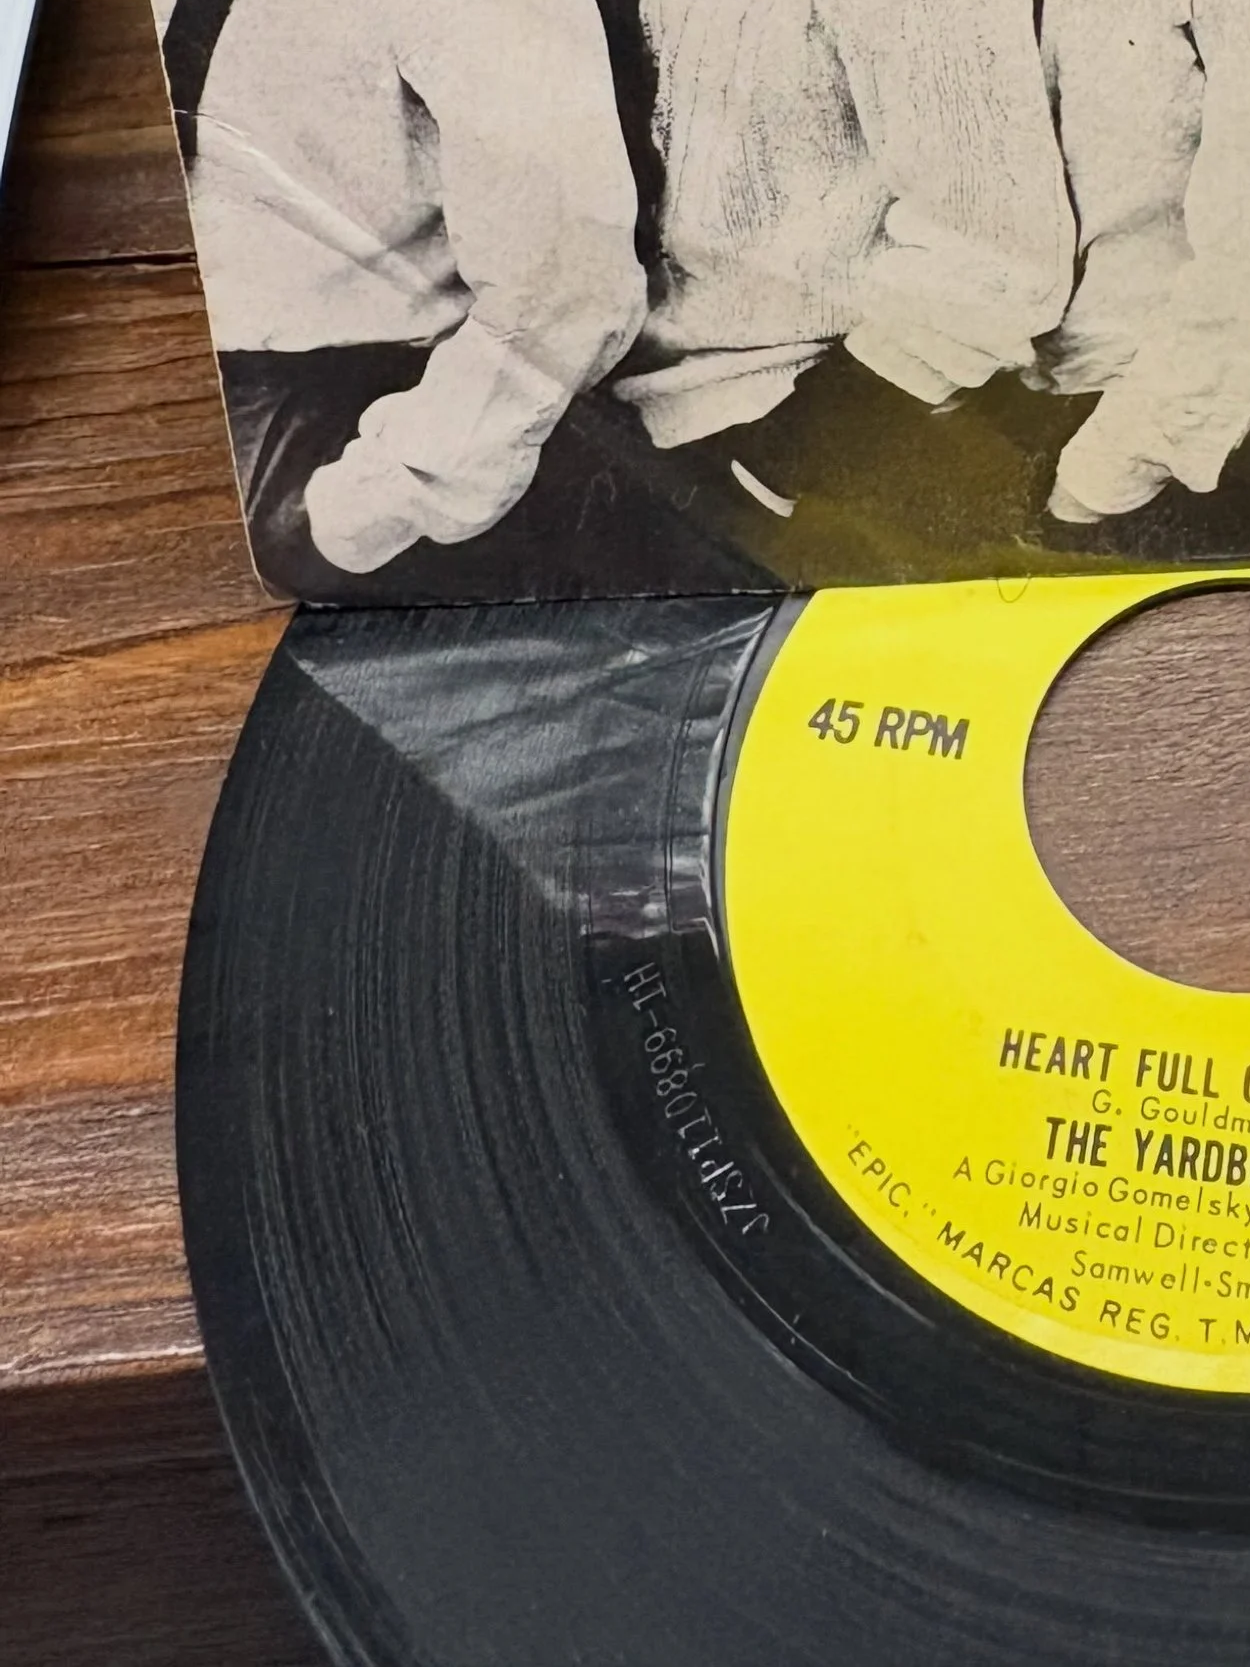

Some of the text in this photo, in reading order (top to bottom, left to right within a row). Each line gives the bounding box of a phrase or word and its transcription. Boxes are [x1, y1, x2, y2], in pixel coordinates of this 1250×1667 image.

[807, 697, 971, 761] 45 RPM
[999, 1027, 1119, 1082] HEART
[1135, 1048, 1220, 1099] FULL
[1092, 1089, 1123, 1117] G.
[1045, 1116, 1113, 1168] THE
[952, 1155, 973, 1182] A
[984, 1160, 1099, 1199] Giorgio
[1018, 1201, 1143, 1244] Musical
[936, 1220, 1081, 1312] MARCAS
